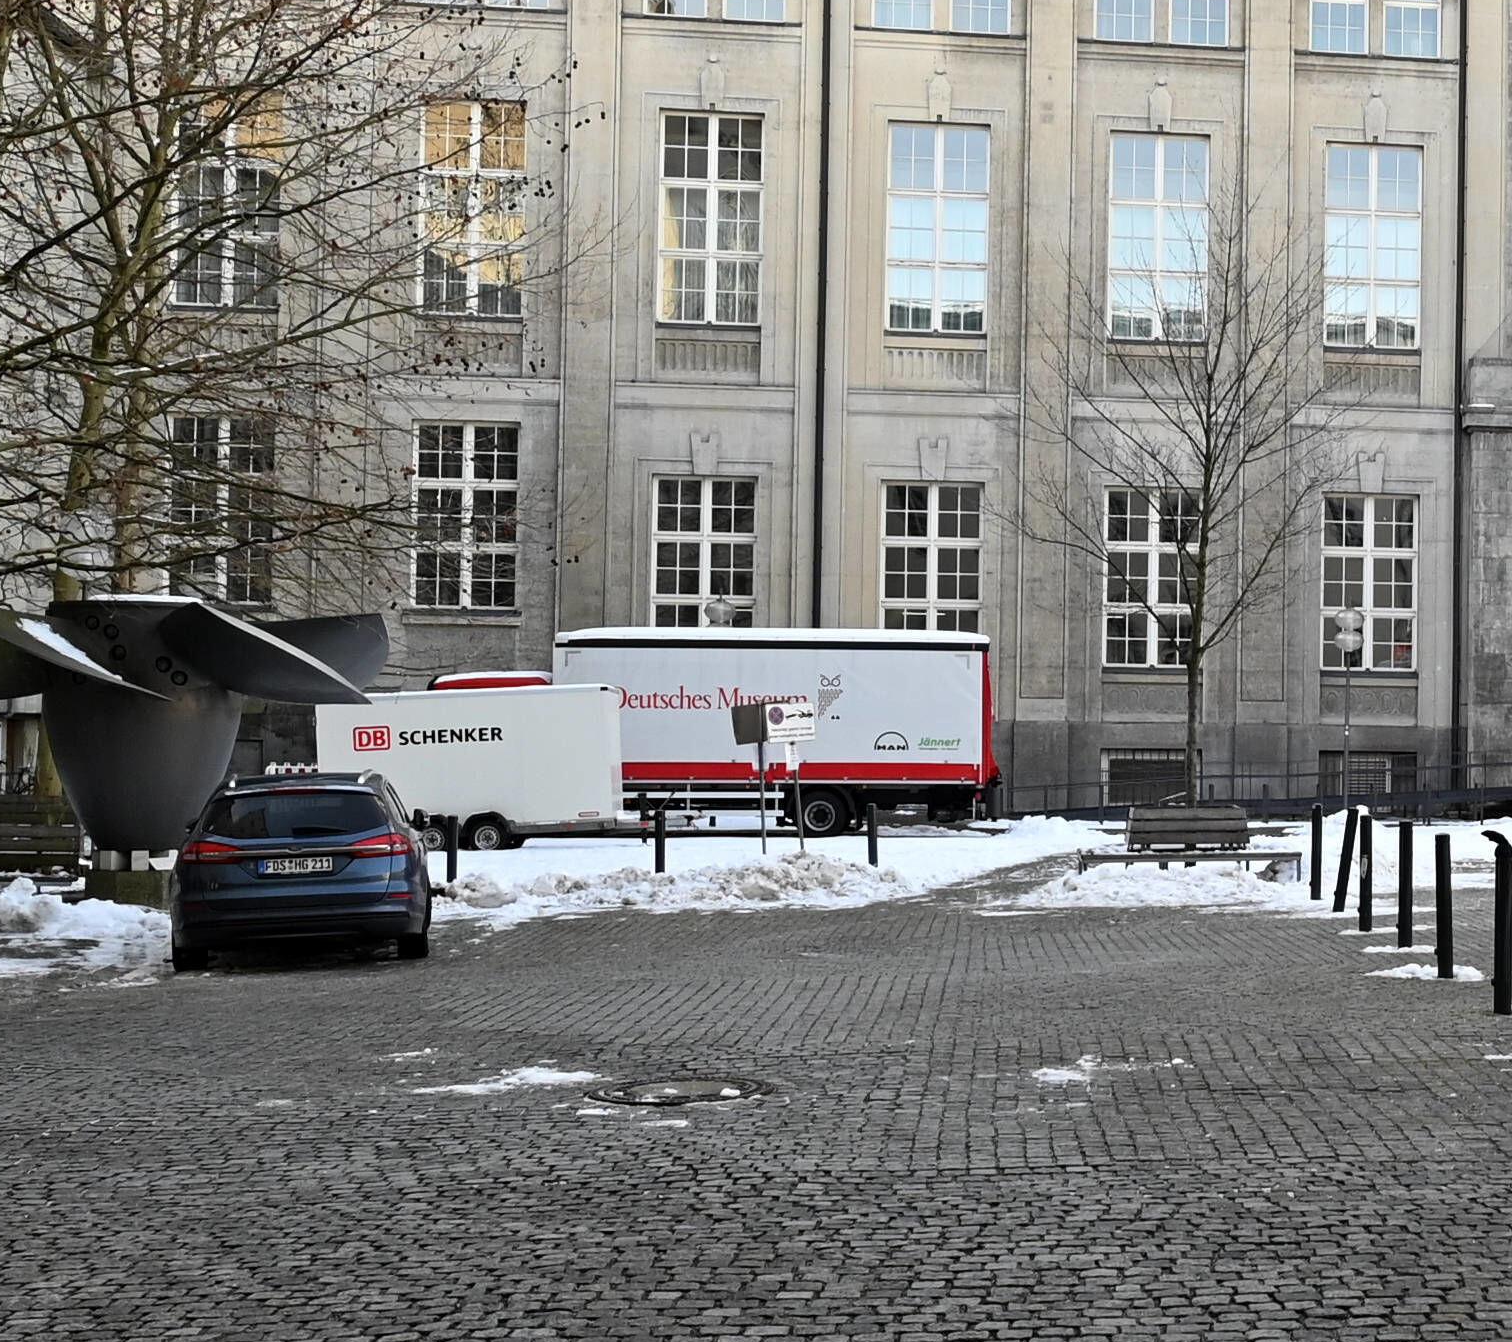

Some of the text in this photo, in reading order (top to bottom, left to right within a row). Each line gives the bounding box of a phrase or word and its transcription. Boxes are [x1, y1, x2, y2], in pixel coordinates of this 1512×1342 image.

[357, 727, 503, 748] DB SCHENKER
[918, 737, 961, 747] Jännert
[265, 858, 332, 871] FDS HG 211
